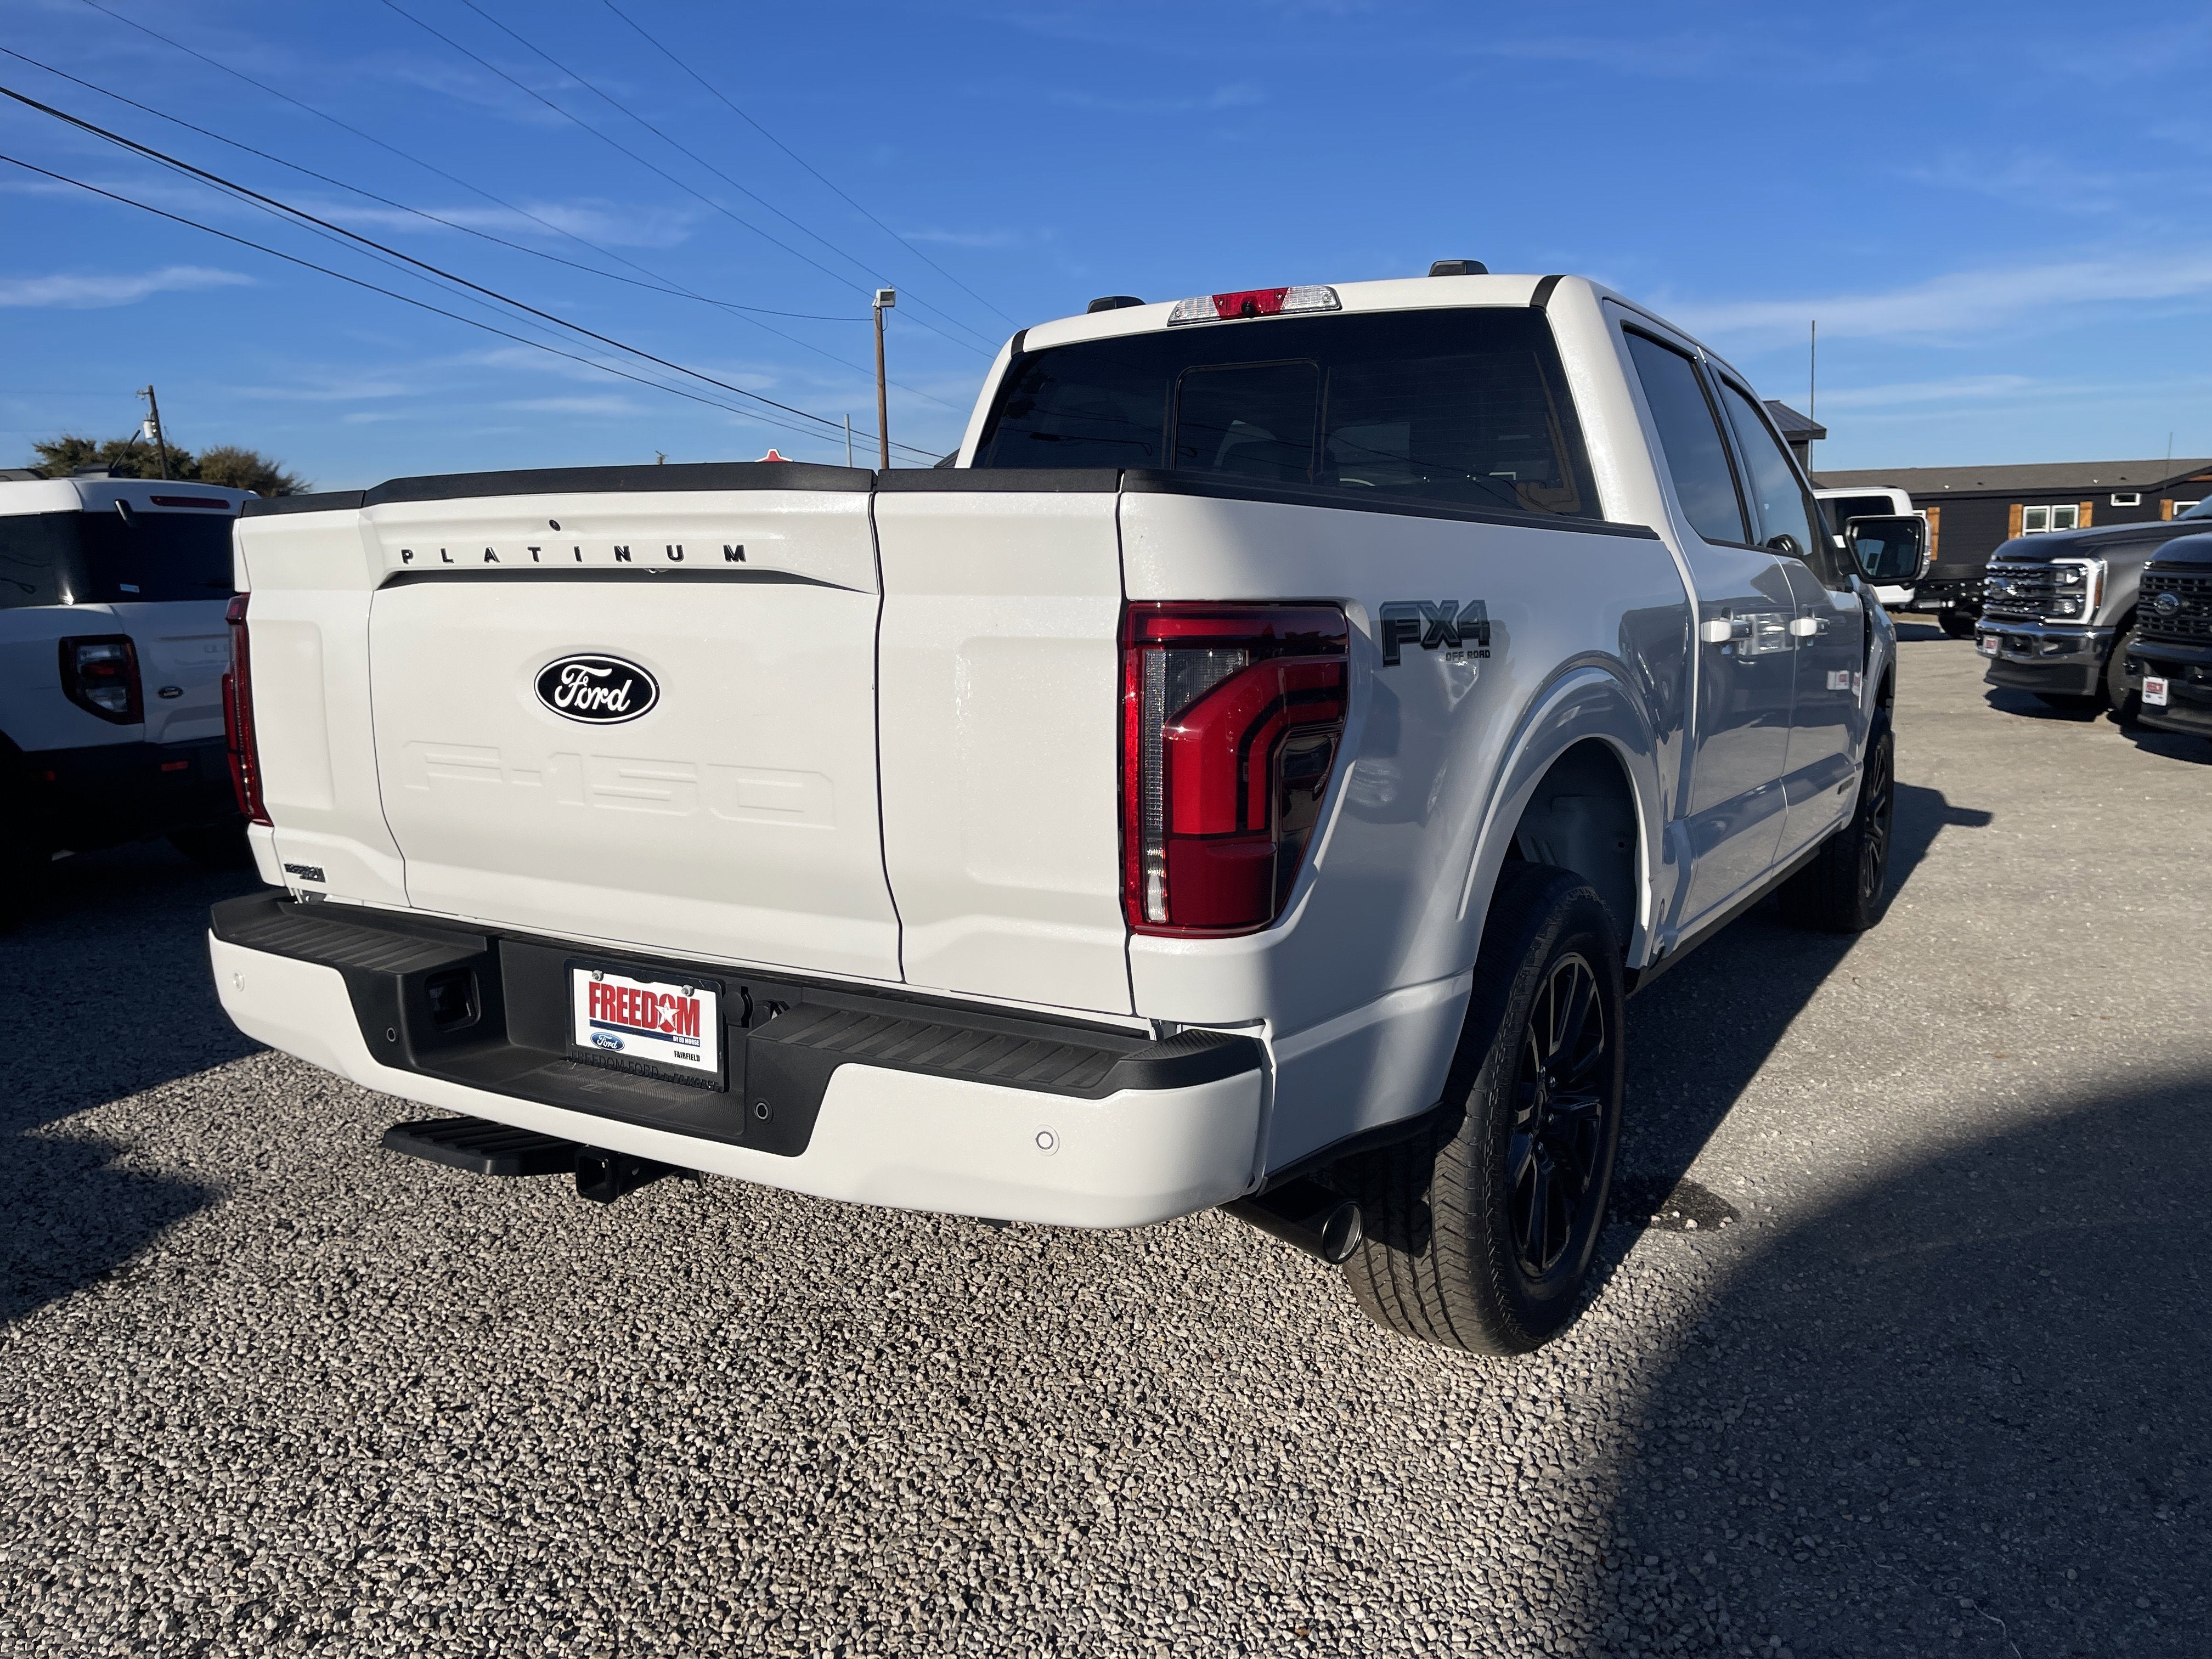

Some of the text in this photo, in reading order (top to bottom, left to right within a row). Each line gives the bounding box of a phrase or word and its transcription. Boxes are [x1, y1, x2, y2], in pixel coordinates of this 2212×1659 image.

[401, 544, 747, 564] PLATINUM
[1379, 599, 1491, 668] FX4
[1445, 649, 1491, 662] OFF ROAD
[554, 664, 633, 712] Ford
[589, 981, 701, 1037] FREEDOM
[674, 1050, 701, 1062] FAIRFIELD
